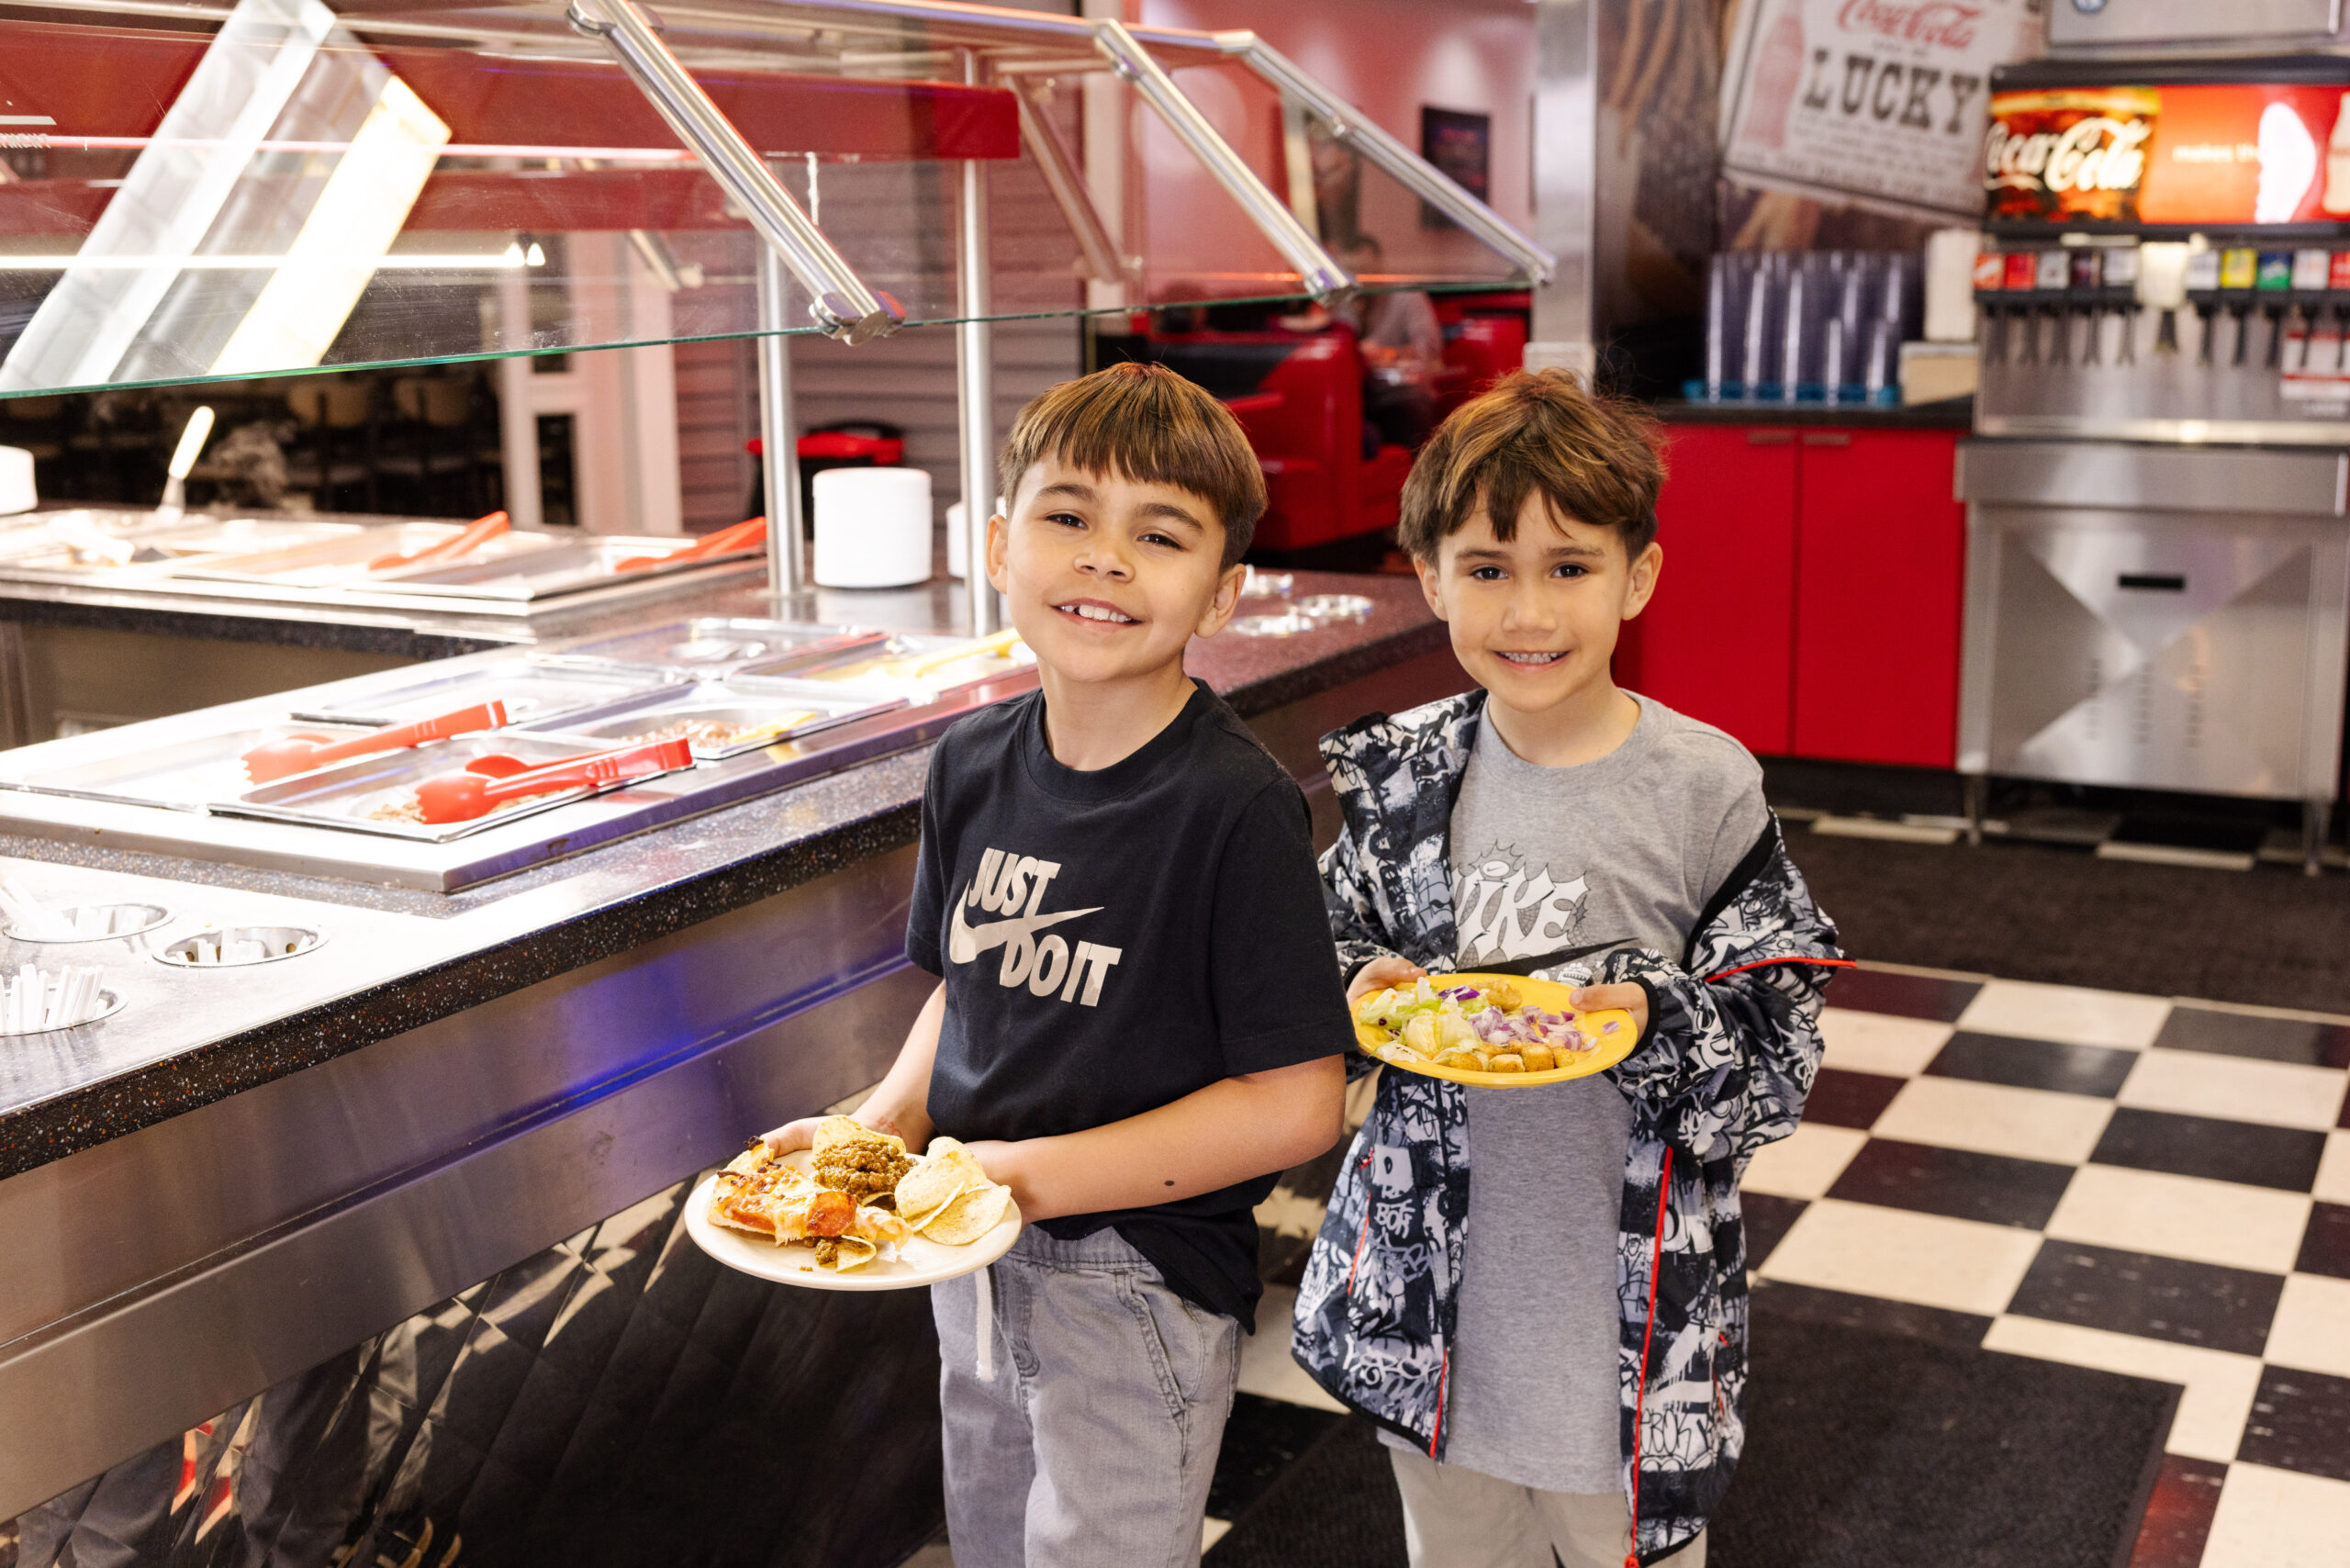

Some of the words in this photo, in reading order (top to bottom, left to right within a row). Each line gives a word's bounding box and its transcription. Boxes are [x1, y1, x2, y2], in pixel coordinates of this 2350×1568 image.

[1803, 48, 1980, 134] LUCKY
[2171, 142, 2234, 163] makes
[968, 847, 1061, 918] JUST
